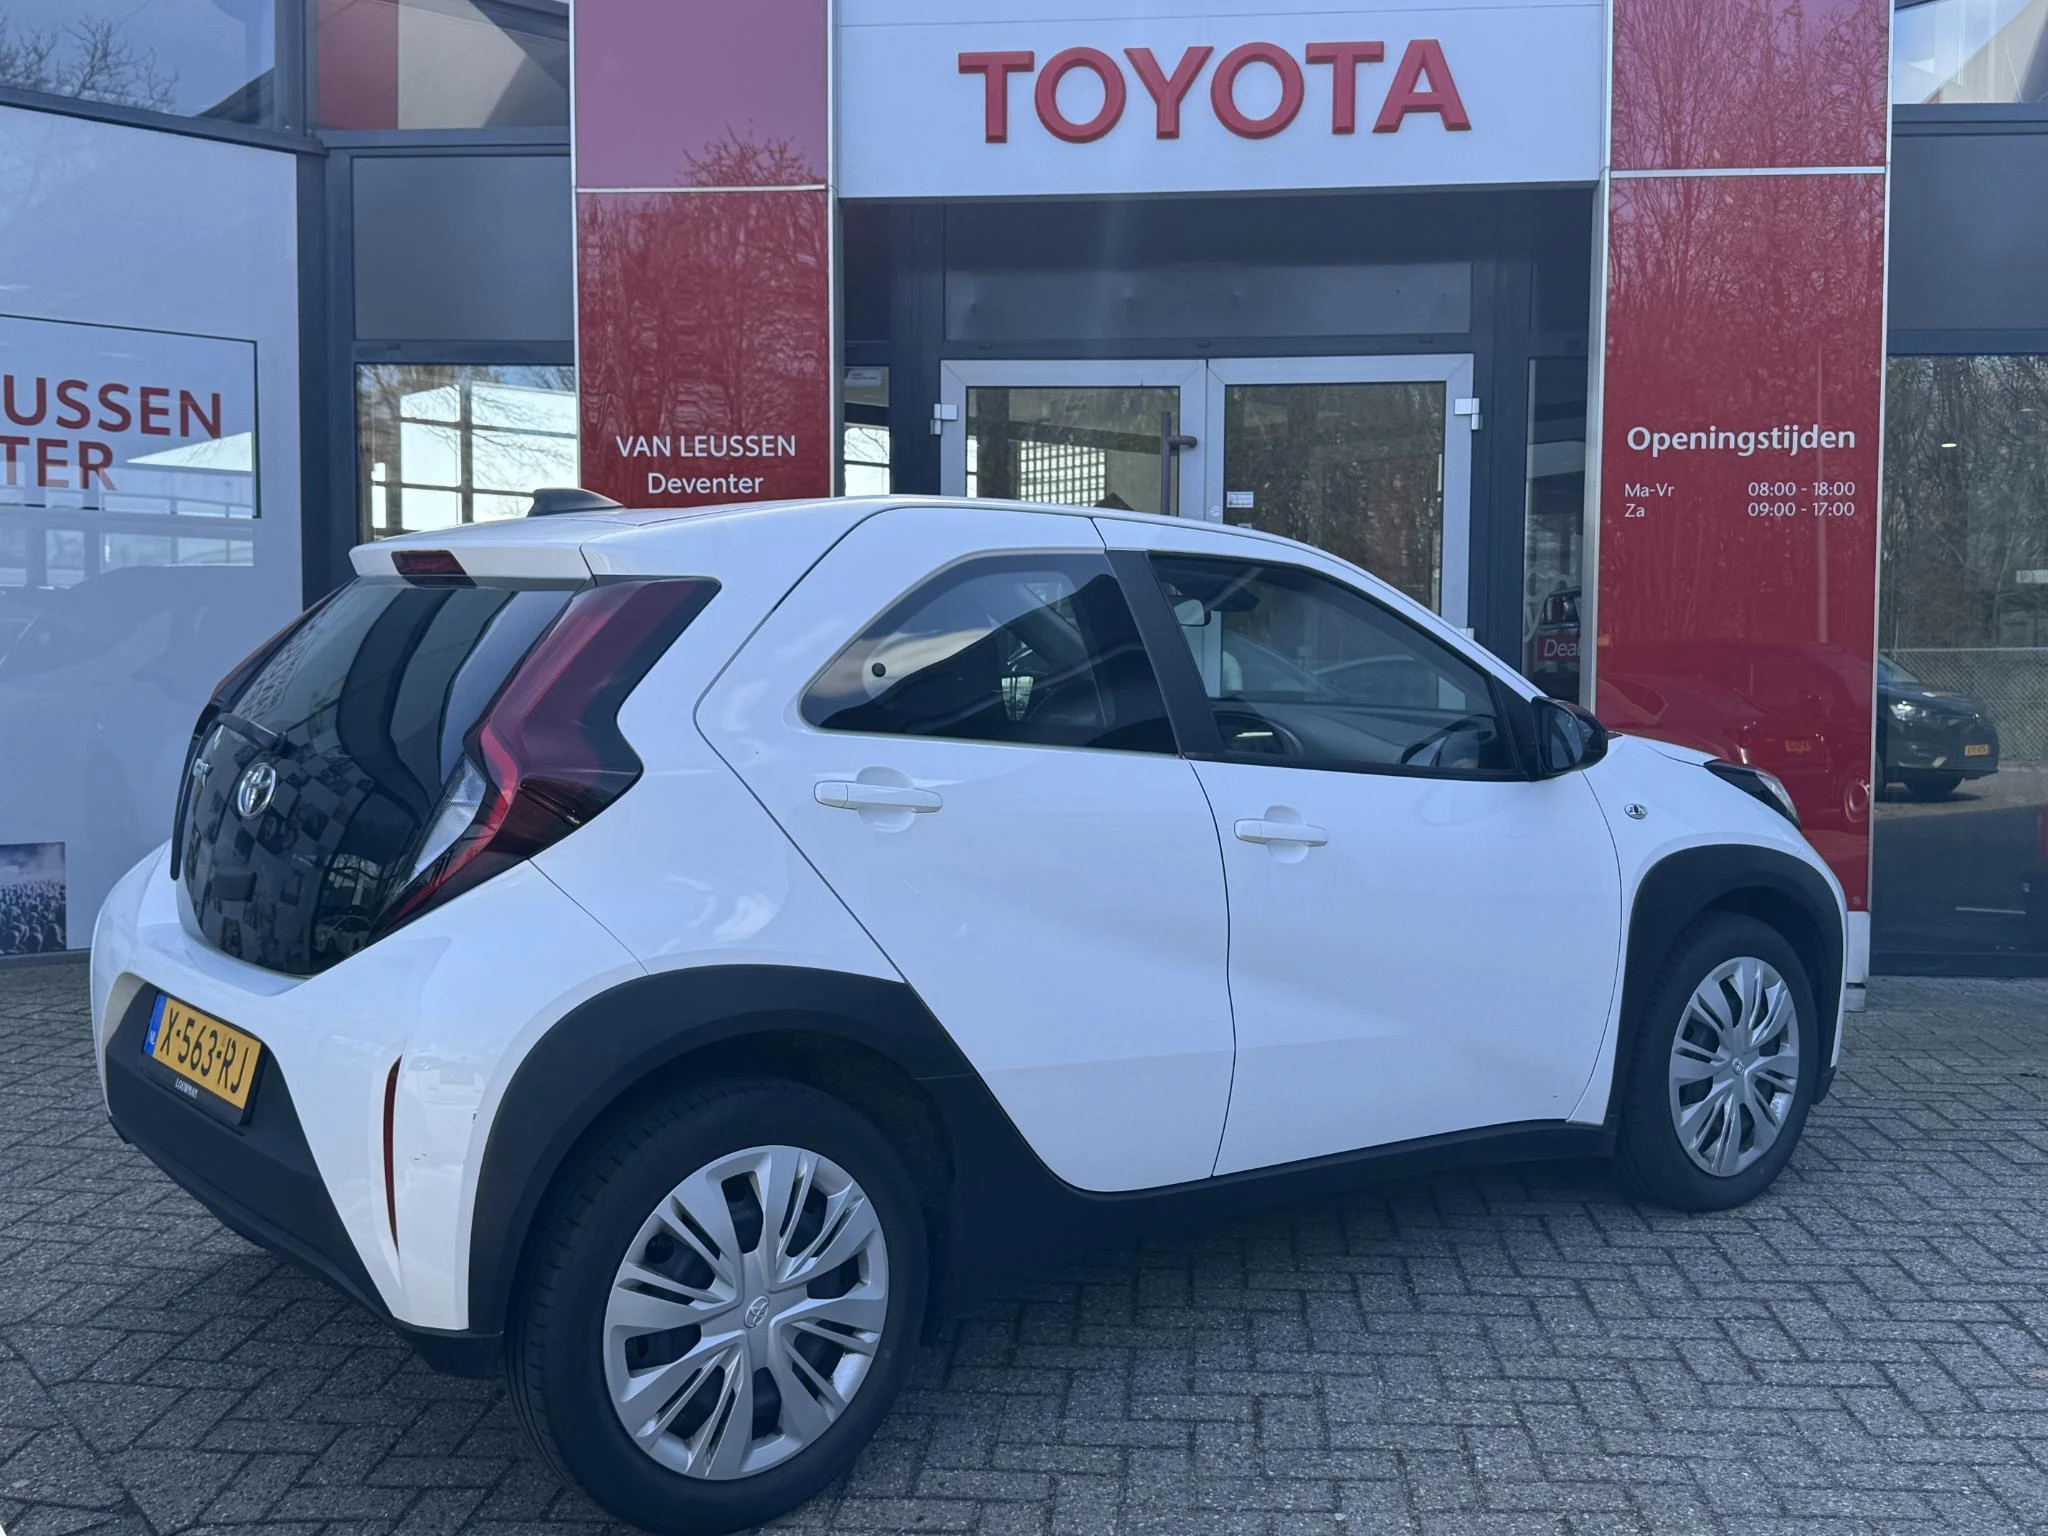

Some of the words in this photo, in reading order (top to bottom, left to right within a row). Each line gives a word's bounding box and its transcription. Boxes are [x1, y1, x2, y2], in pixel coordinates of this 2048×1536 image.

[958, 38, 1472, 145] TOYOTA
[615, 435, 672, 458] VAN
[679, 435, 797, 458] LEUSSEN
[1626, 423, 1856, 458] Openingstijden
[0, 434, 118, 492] TER
[647, 471, 764, 495] Deventer
[1624, 482, 1675, 498] Ma-Vr
[1747, 481, 1797, 497] 08:00
[1812, 481, 1856, 497] 18:00
[1624, 503, 1645, 518] Za
[1747, 502, 1797, 518] 09:00
[1812, 501, 1856, 517] 17:00
[160, 1007, 250, 1094] X-563-RJ
